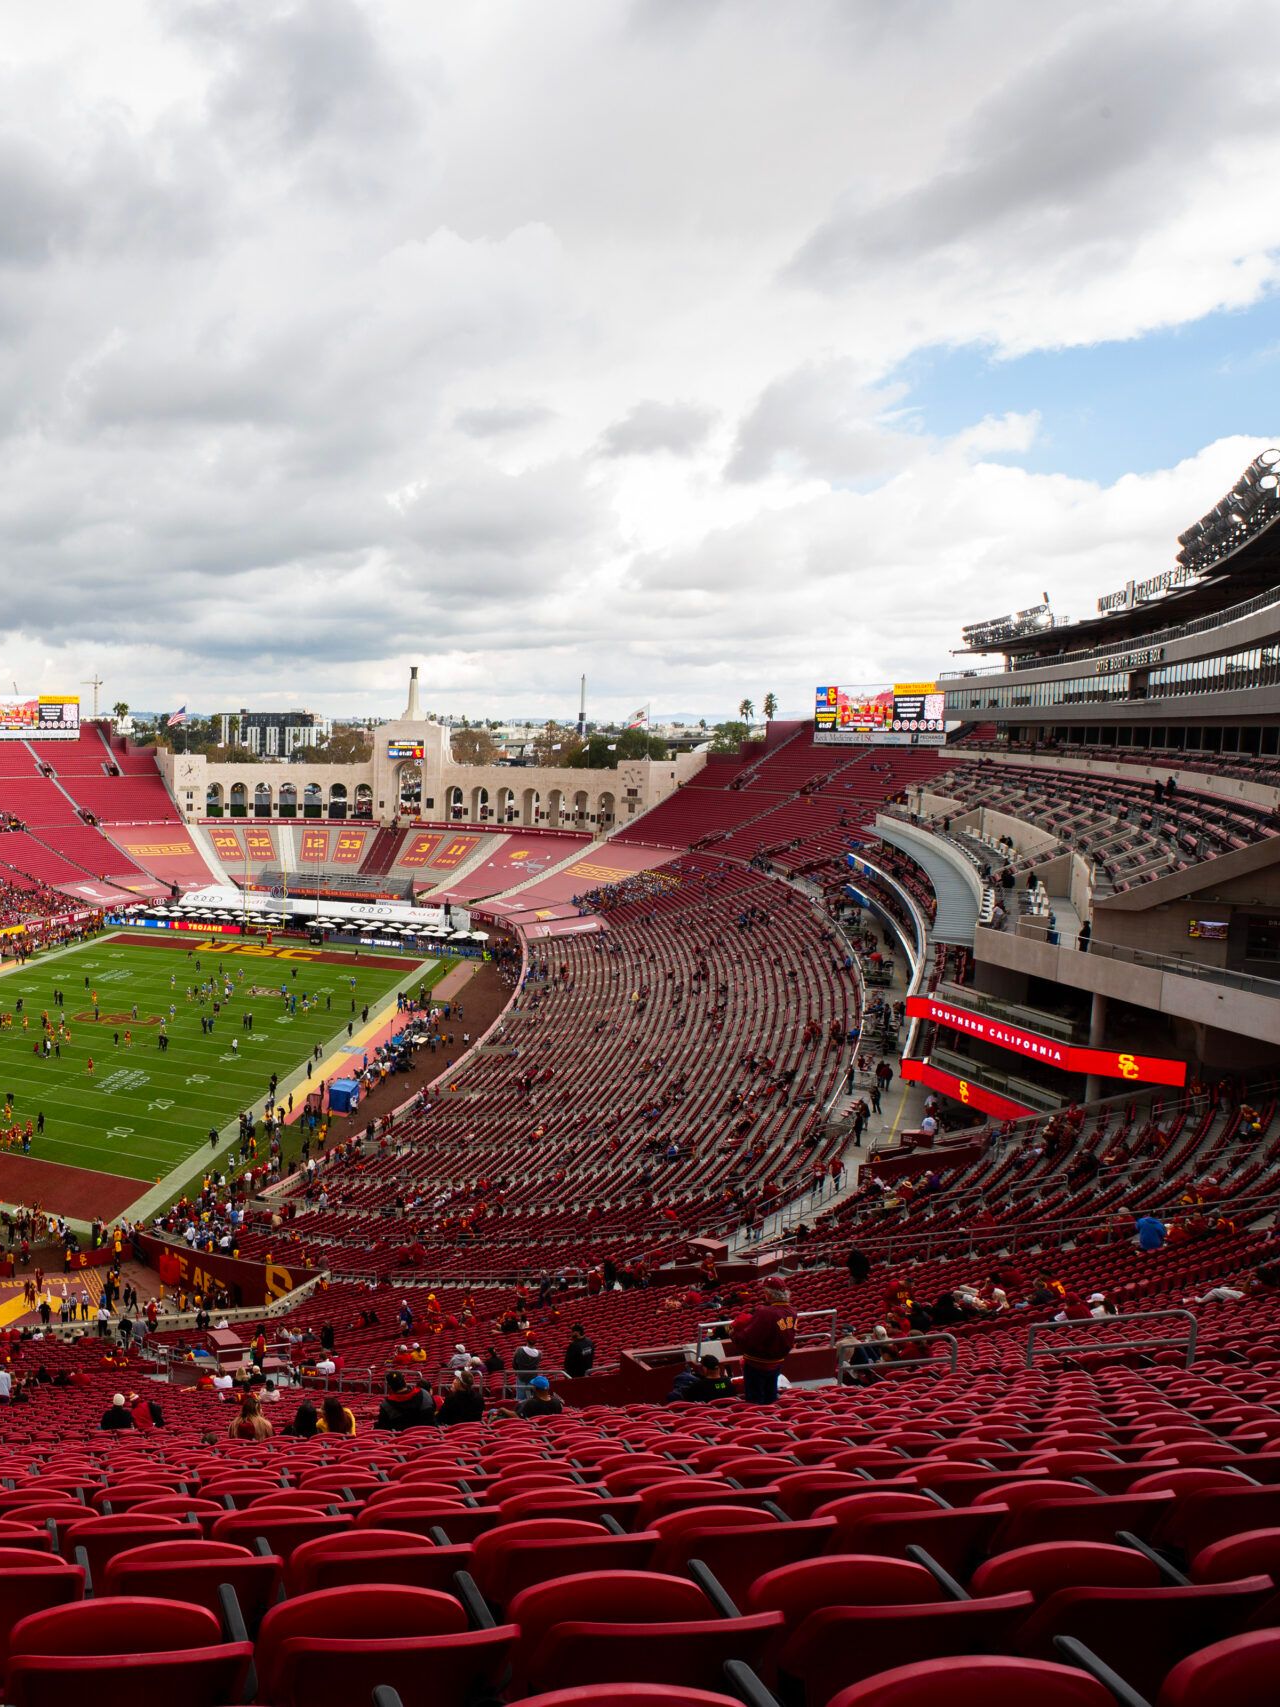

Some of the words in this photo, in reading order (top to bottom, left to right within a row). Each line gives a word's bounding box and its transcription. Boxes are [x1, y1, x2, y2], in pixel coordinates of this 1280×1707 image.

[1097, 590, 1126, 612] UNITED
[1134, 570, 1171, 601] AIRLINES
[1096, 659, 1110, 672] OTIS
[1110, 654, 1129, 670] BOOTH
[1130, 651, 1148, 665] PRESS
[1149, 648, 1163, 662] BOX
[860, 733, 873, 743] USC
[215, 838, 237, 847] 20
[248, 838, 271, 847] 32
[306, 838, 324, 848] 12
[339, 839, 362, 849] 33
[415, 843, 430, 853] 3
[447, 845, 467, 855] 11
[407, 910, 439, 918] Audi
[188, 923, 223, 932] TROJANS
[360, 938, 391, 946] PREENTED
[195, 942, 322, 960] USC
[931, 1008, 984, 1033] SOUTHERN
[989, 1028, 1062, 1061] CALIFORNIA
[1118, 1054, 1139, 1079] SC
[959, 1080, 969, 1104] SC
[148, 1098, 176, 1111] 20
[107, 1126, 134, 1138] 10
